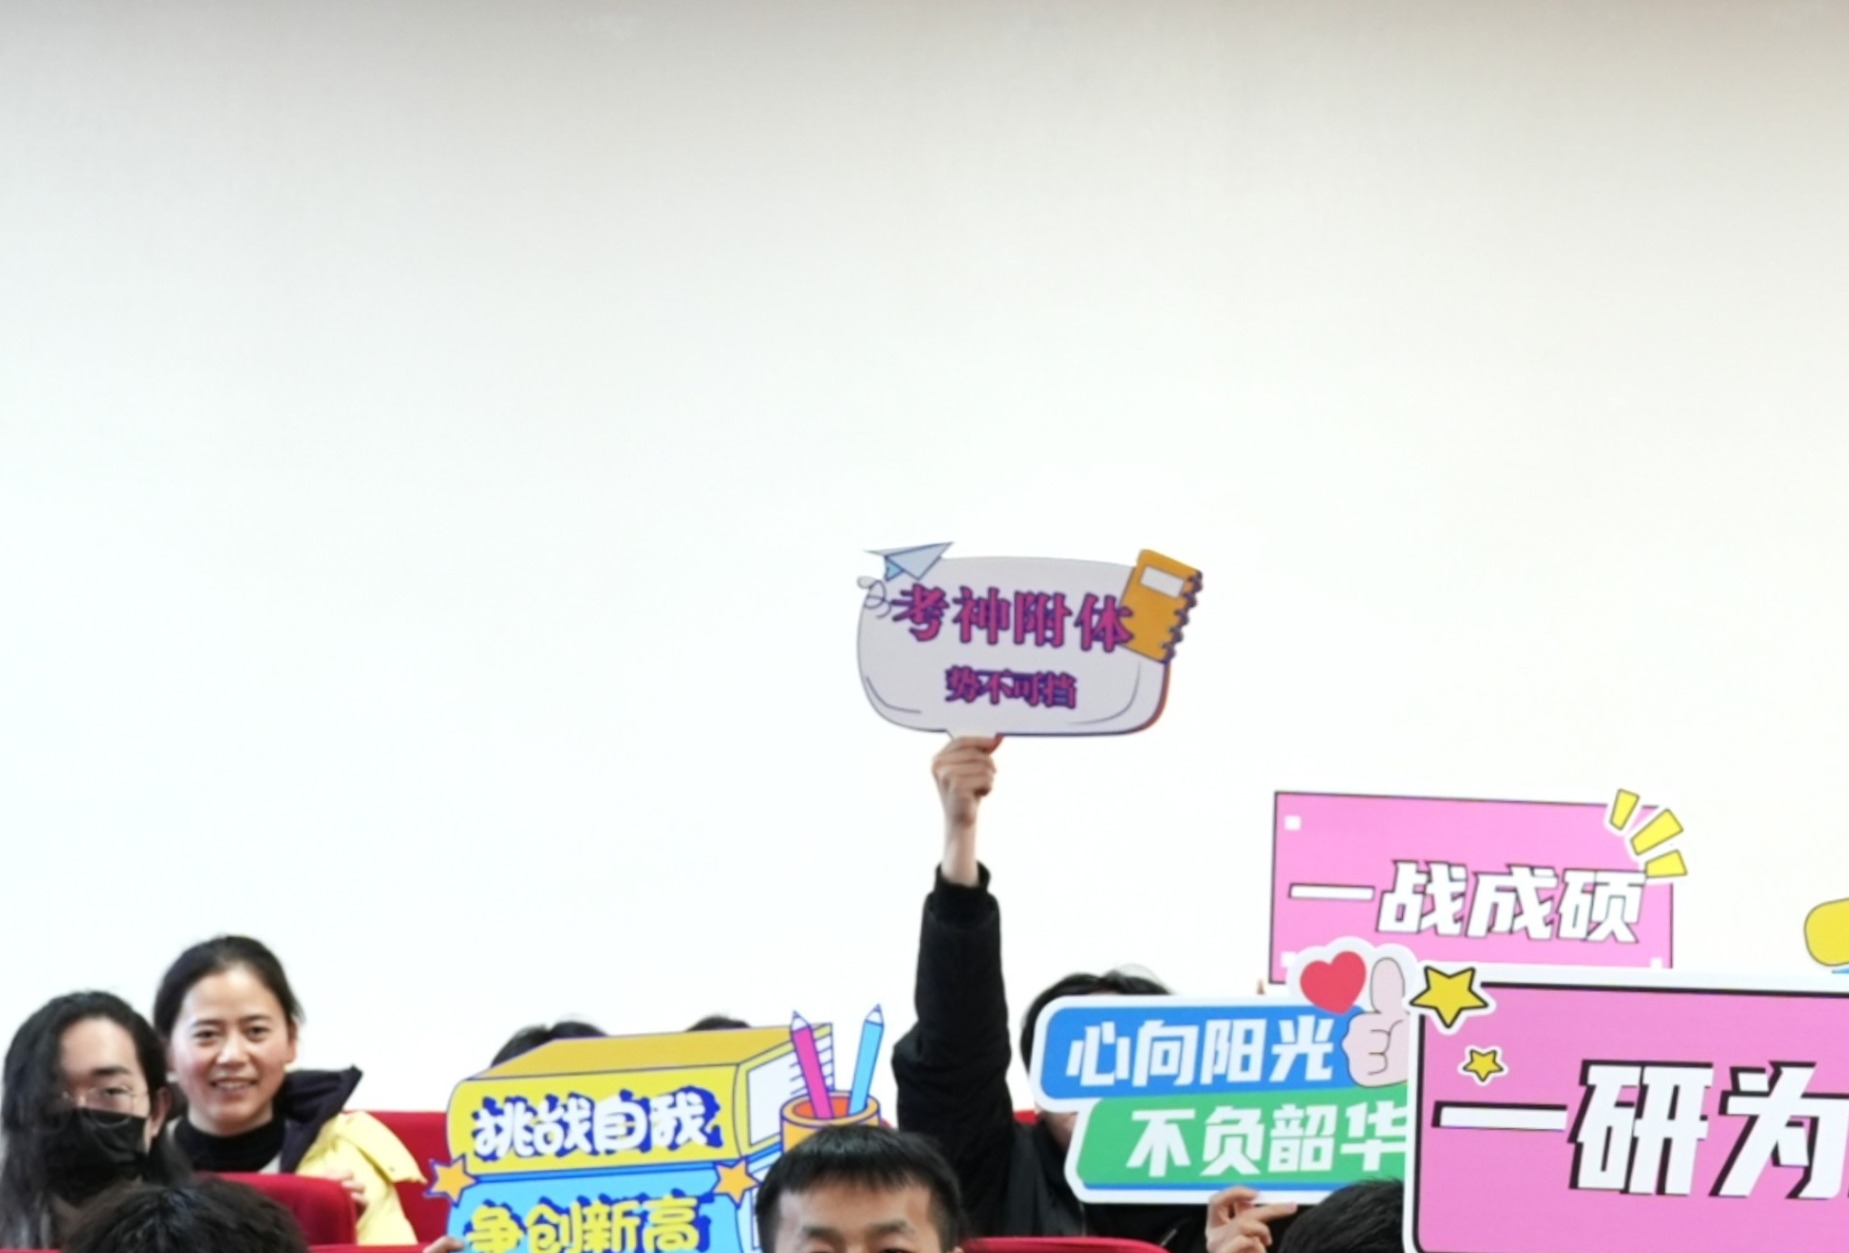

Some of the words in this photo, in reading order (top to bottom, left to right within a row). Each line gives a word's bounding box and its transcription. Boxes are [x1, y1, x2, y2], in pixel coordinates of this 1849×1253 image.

[891, 583, 1134, 653] 考神附体
[945, 664, 1078, 709] 势不可挡
[1288, 859, 1648, 944] 一战成硕
[1065, 1014, 1335, 1088] 心向阳光
[472, 1086, 723, 1162] 挑战自我
[1125, 1099, 1408, 1178] 不负韶华
